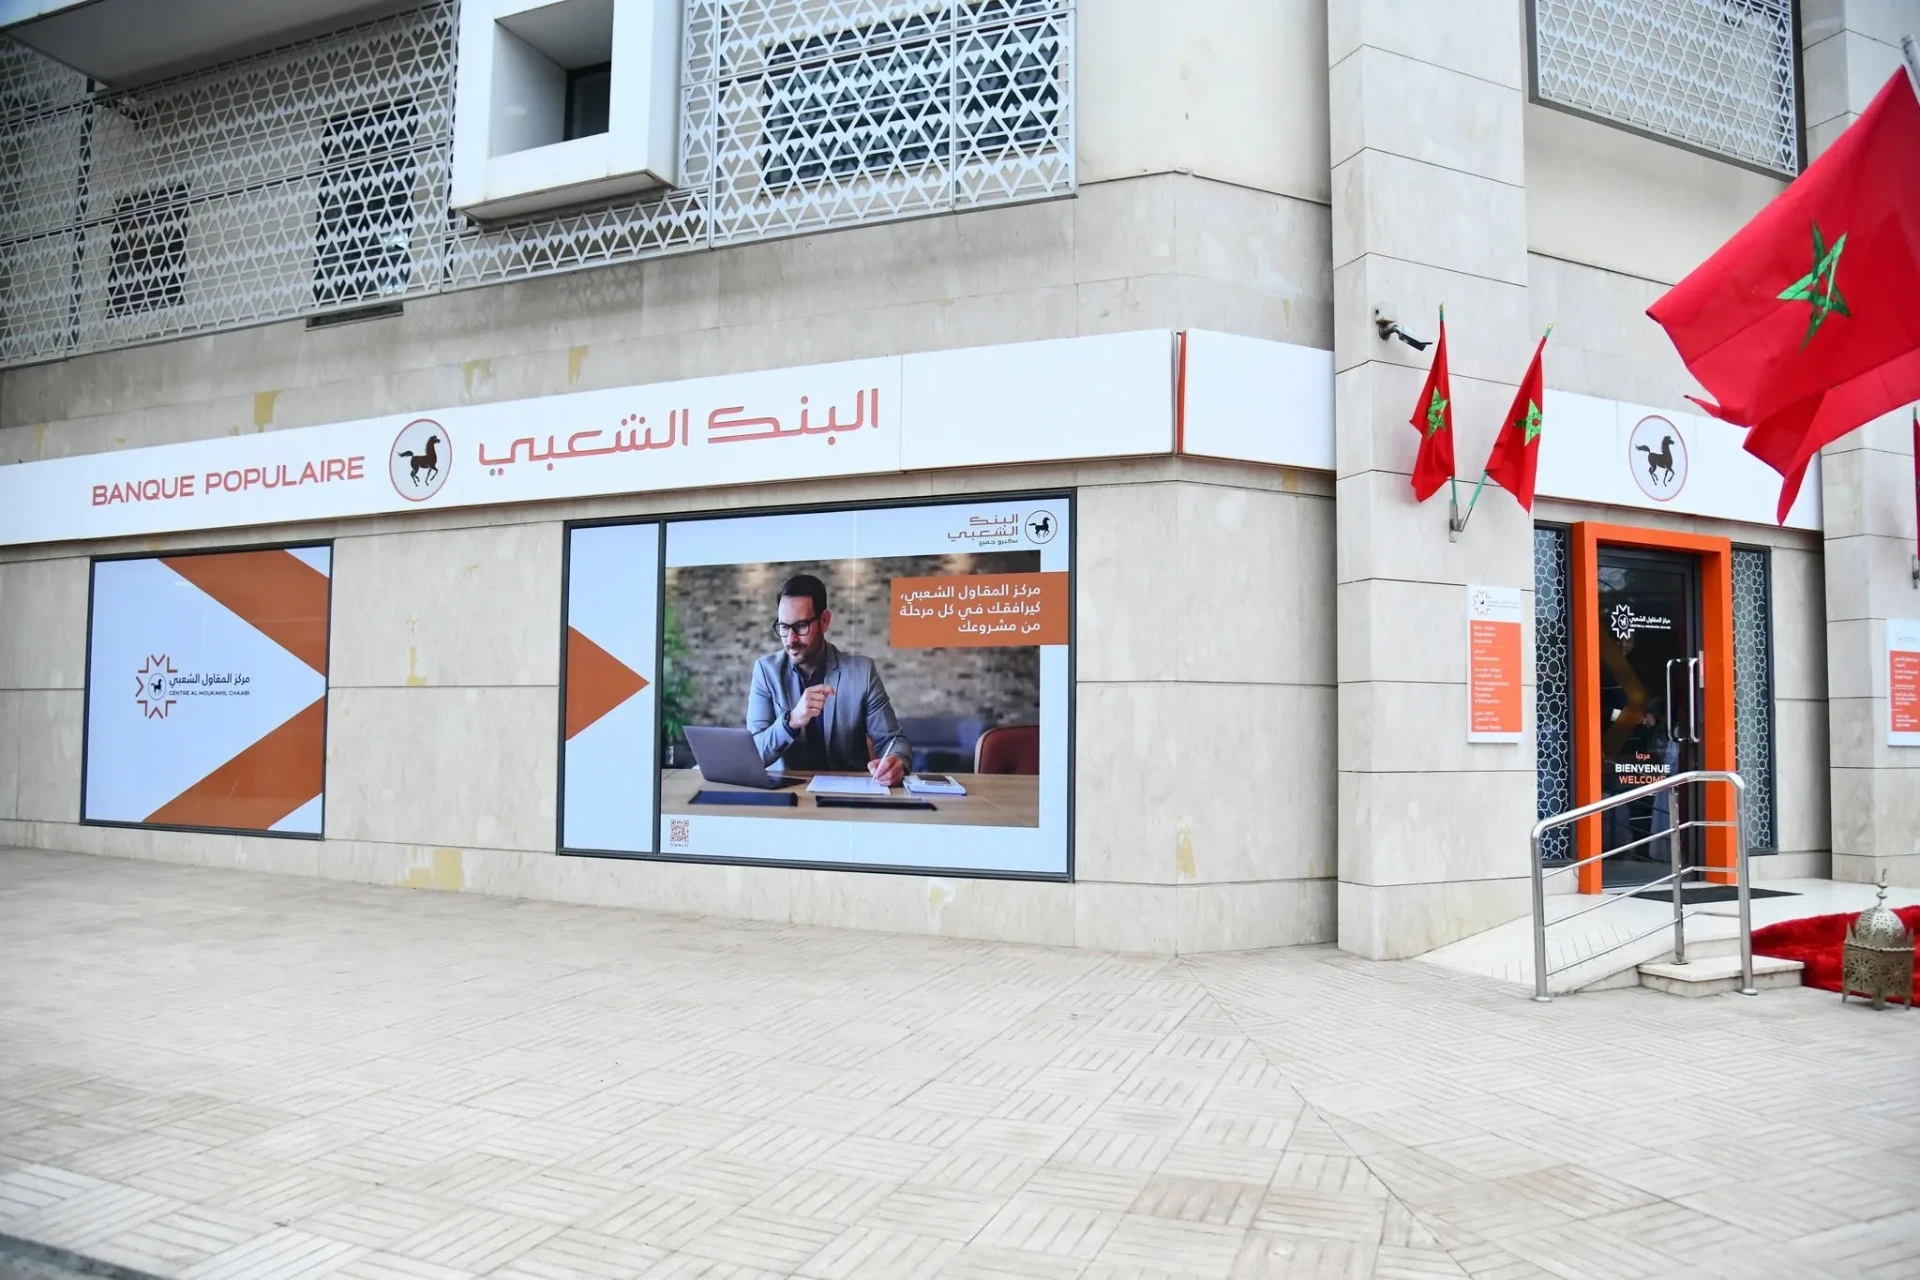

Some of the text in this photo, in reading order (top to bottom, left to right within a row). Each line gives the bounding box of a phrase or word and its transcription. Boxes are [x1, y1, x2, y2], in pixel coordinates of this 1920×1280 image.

[478, 388, 879, 476] البنك الشعبي
[92, 456, 366, 507] BANQUE POPULAIRE
[969, 513, 1019, 528] البنك
[947, 526, 1019, 542] الشعبي
[958, 584, 1009, 600] المقاول
[1013, 583, 1041, 599] مركز
[899, 601, 1041, 620] كيرافقك في كل مرحلة
[958, 619, 1041, 635] من مشروعك
[169, 673, 250, 688] مركز المقاول الشعبي
[1615, 764, 1670, 773] BIENVENUE
